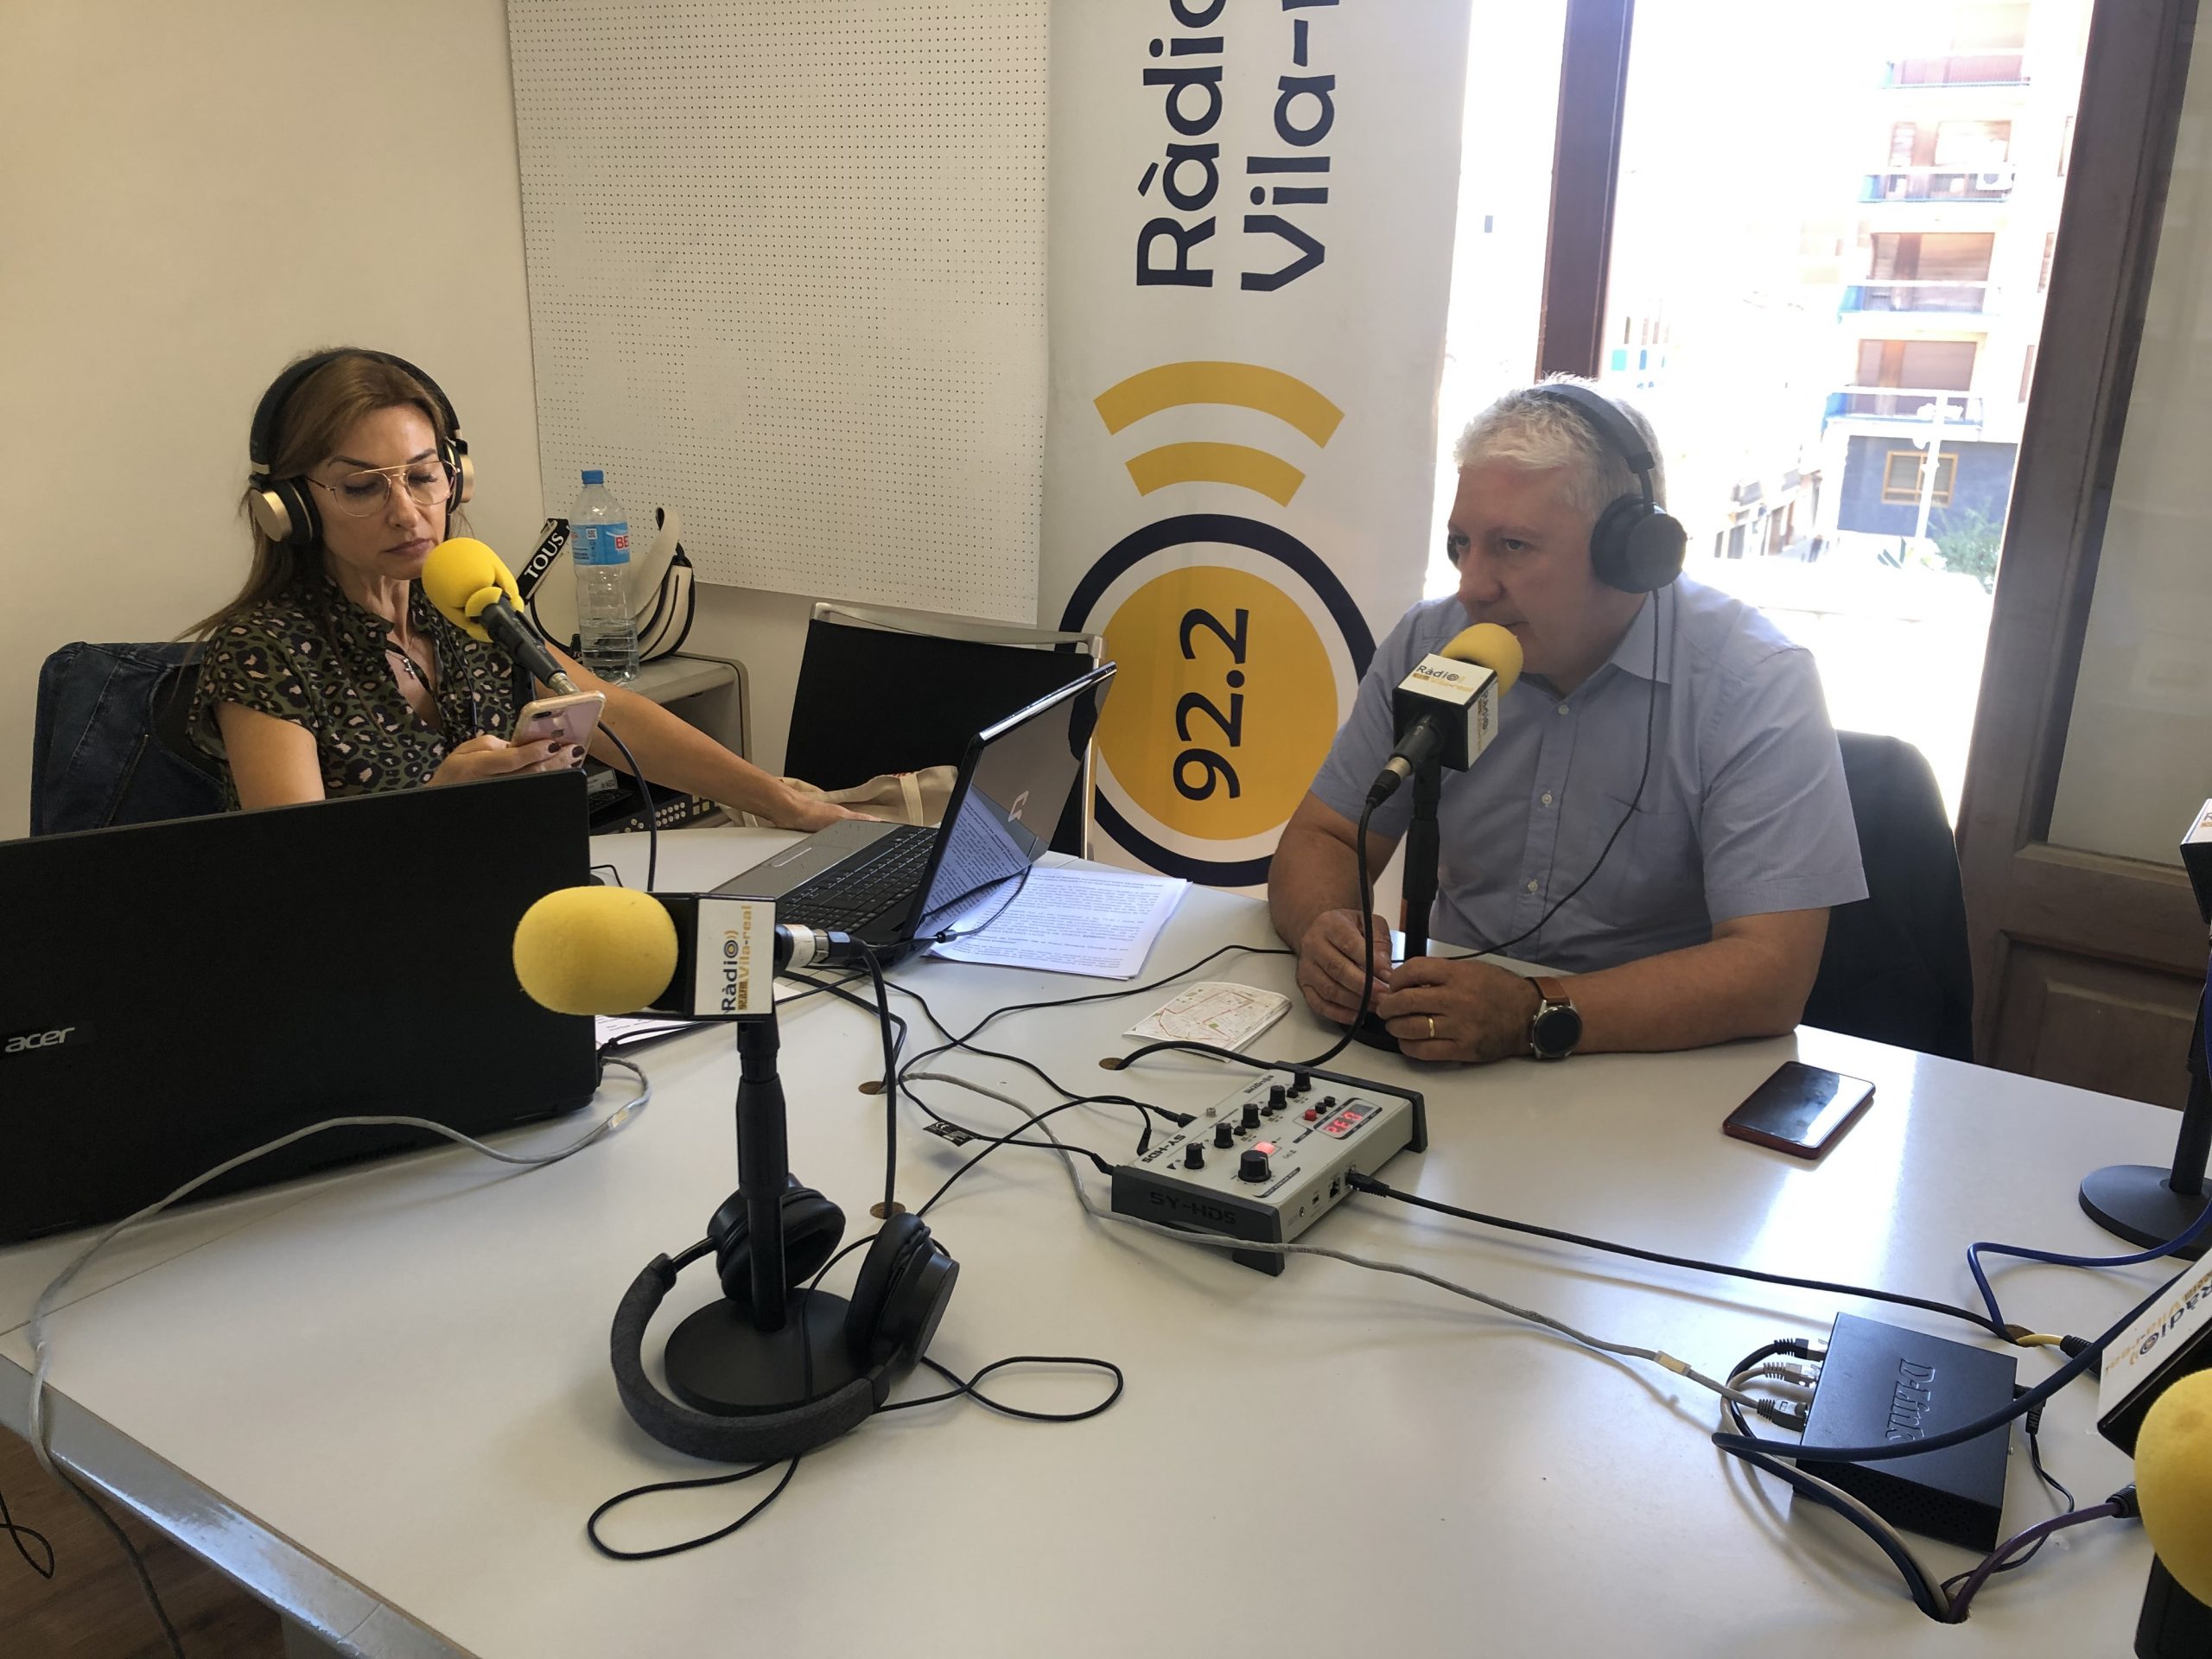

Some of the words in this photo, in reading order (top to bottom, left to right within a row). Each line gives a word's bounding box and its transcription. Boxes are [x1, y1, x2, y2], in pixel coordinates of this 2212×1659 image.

[524, 532, 564, 578] TOUS
[1173, 608, 1249, 801] 92.2
[739, 906, 752, 979] Vila-real
[721, 939, 739, 1011] Ràdio
[5, 1027, 75, 1052] acer
[1141, 1134, 1186, 1163] SY-HDS
[1150, 1192, 1236, 1224] SY-HDS
